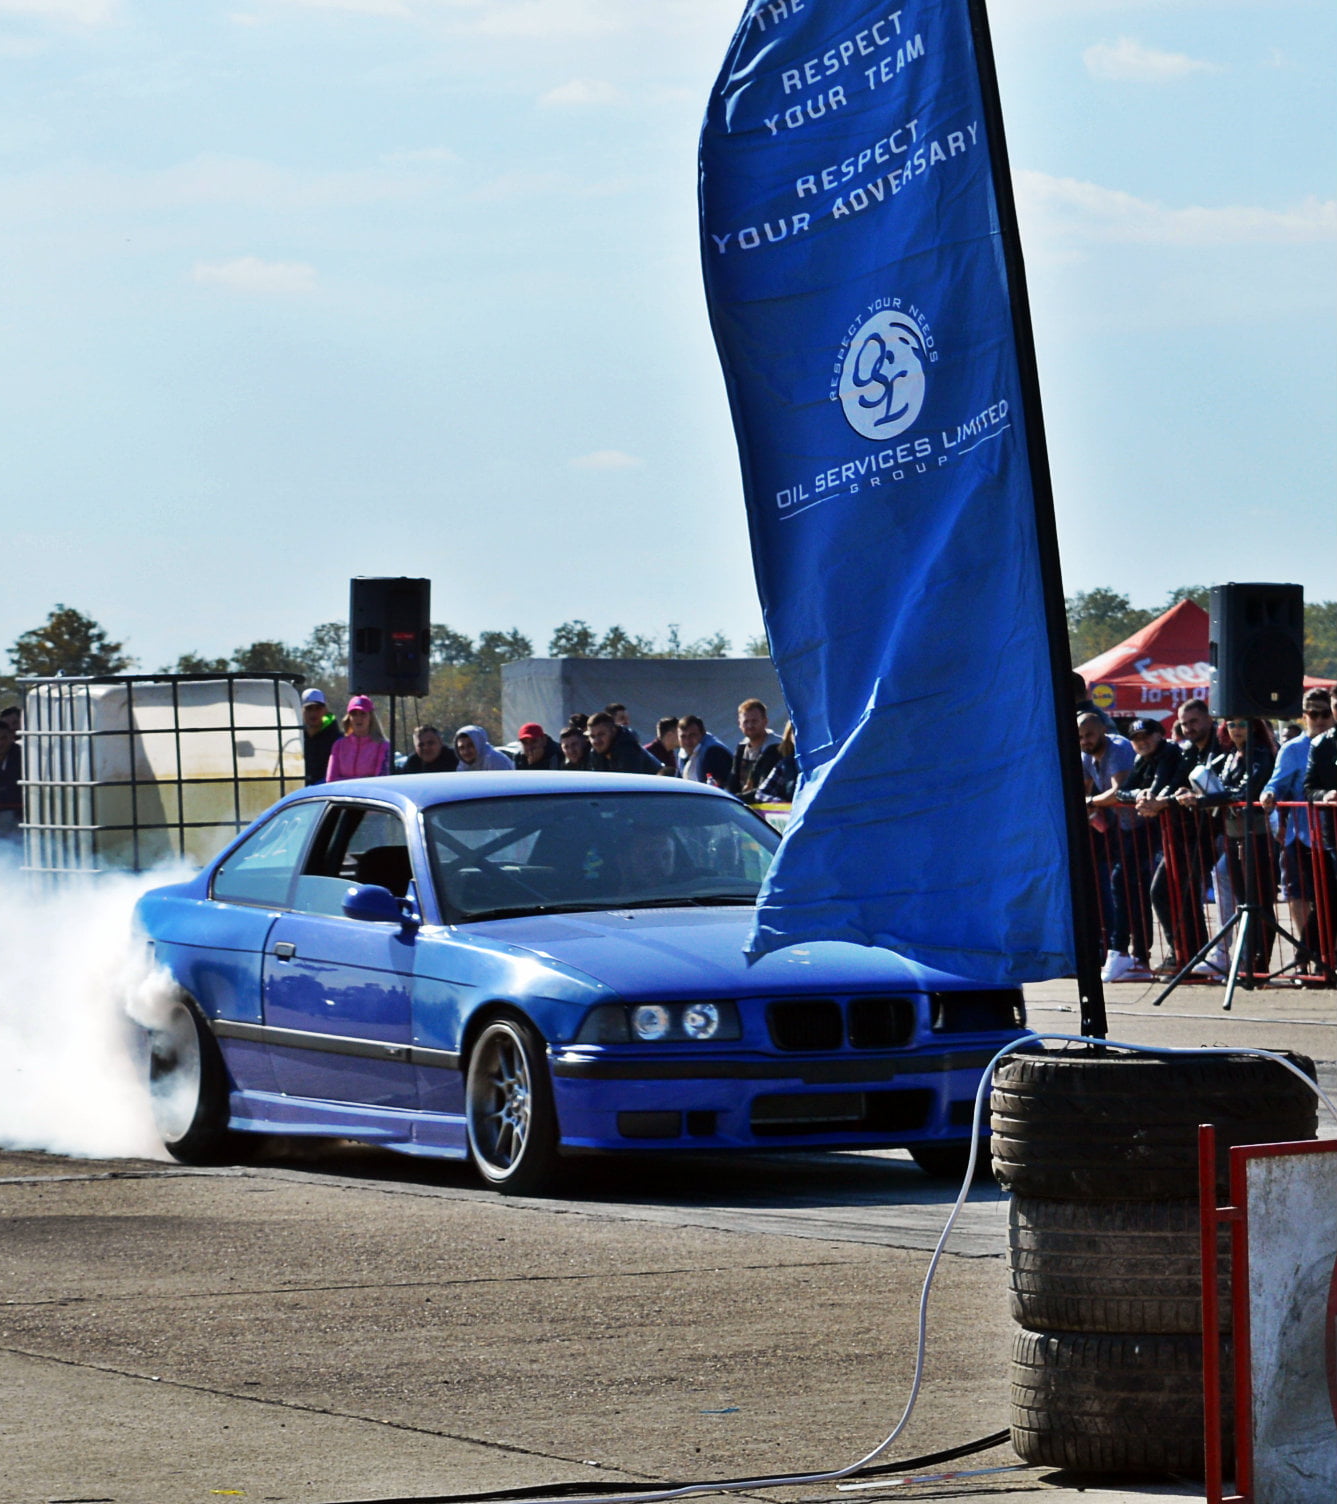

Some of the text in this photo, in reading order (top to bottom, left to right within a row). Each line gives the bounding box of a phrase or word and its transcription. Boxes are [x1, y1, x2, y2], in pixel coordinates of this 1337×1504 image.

[752, 0, 805, 31] THE
[782, 10, 903, 94] RESPECT
[764, 33, 925, 136] YOUR TEAM
[712, 120, 978, 254] YOUR ADVERSARY
[797, 119, 919, 198] RESPECT
[829, 297, 938, 401] RESPECT YOUR NEEDS
[776, 399, 1009, 509] OIL SERVICES LIMITED
[850, 455, 948, 494] GROUP
